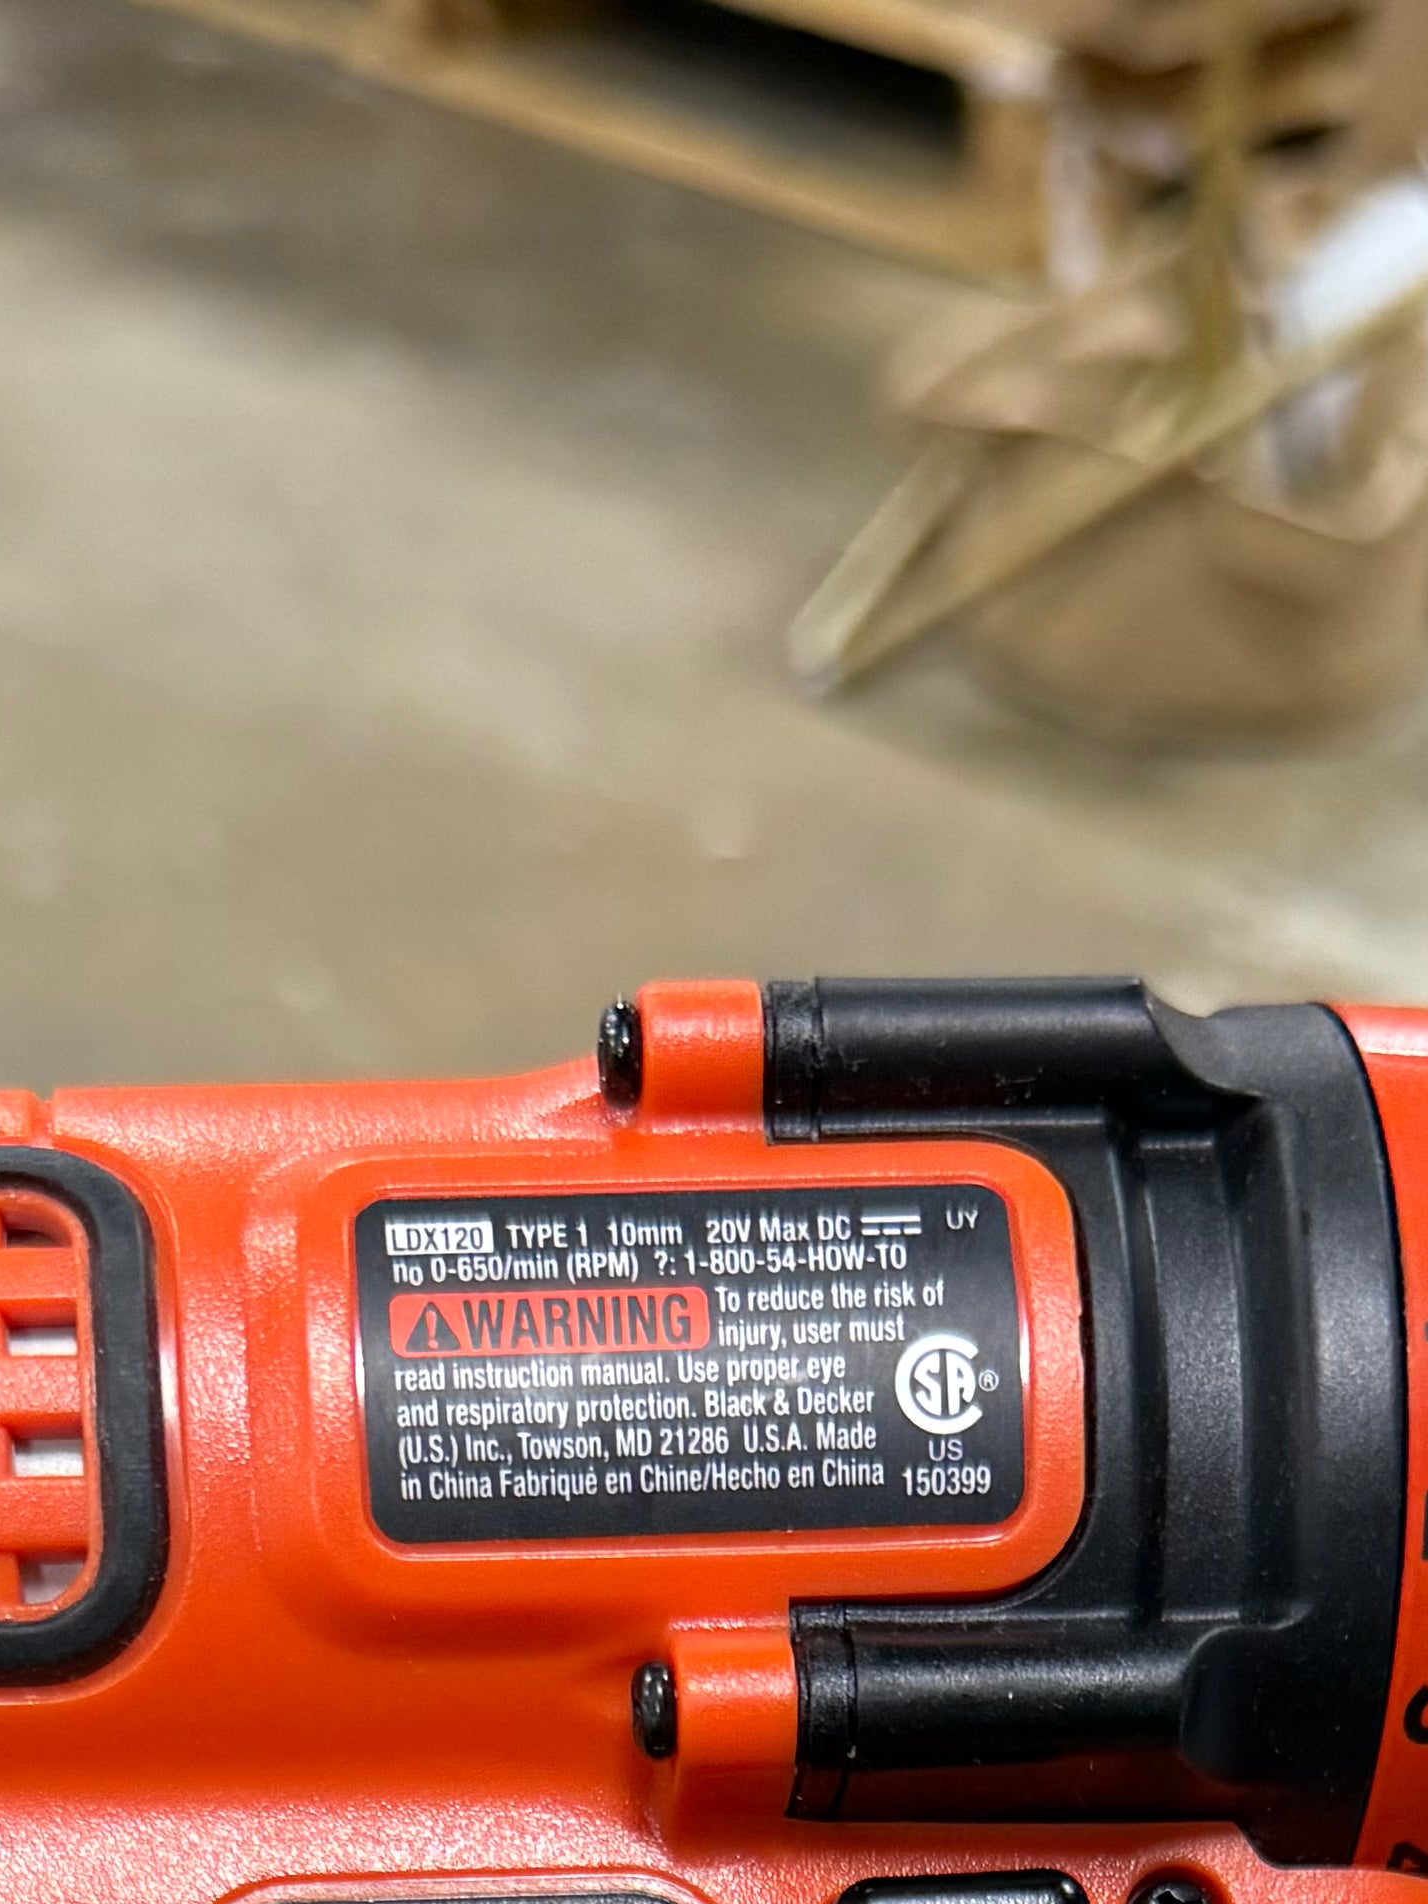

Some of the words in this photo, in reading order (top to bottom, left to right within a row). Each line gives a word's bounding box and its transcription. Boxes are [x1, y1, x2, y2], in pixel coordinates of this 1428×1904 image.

[391, 1227, 484, 1251] LDX120
[506, 1222, 568, 1249] TYPE
[576, 1219, 588, 1248] 1
[608, 1219, 682, 1247] 10mm
[706, 1217, 751, 1244] 20V
[759, 1216, 810, 1242] Max
[817, 1215, 851, 1241] DC
[946, 1208, 978, 1230] UY
[430, 1253, 559, 1282] 0-650/min
[567, 1250, 639, 1284] (RPM)
[684, 1243, 907, 1275] 1-800-54-HOW-TO
[714, 1285, 740, 1312] To
[748, 1281, 824, 1311] reduce
[831, 1281, 867, 1309] the
[874, 1280, 916, 1307] risk
[922, 1278, 945, 1306] of
[462, 1293, 691, 1349] WARNING
[718, 1319, 787, 1351] injury,
[793, 1319, 842, 1344] user
[849, 1315, 906, 1342] must
[394, 1362, 445, 1391] read
[452, 1360, 573, 1390] instruction
[580, 1358, 670, 1386] manual.
[677, 1355, 719, 1383] Use
[727, 1357, 800, 1386] proper
[807, 1357, 846, 1380] eye
[397, 1398, 438, 1427] and
[446, 1395, 570, 1431] respiratory
[576, 1391, 697, 1427] protection.
[705, 1388, 766, 1418] Black
[773, 1390, 790, 1416] &
[797, 1387, 875, 1416] Decker
[398, 1434, 459, 1469] (U.S.)
[465, 1433, 513, 1465] Inc.,
[518, 1431, 610, 1462] Towson,
[616, 1428, 652, 1457] MD
[660, 1426, 730, 1456] 21286
[743, 1423, 808, 1453] U.S.A.
[816, 1421, 877, 1451] Made
[928, 1438, 963, 1461] US
[401, 1471, 422, 1500] in
[429, 1470, 493, 1499] China
[499, 1465, 598, 1501] Fabriqué
[605, 1471, 632, 1494] en
[640, 1460, 780, 1492] Chine/Hecho
[788, 1465, 815, 1488] en
[822, 1458, 885, 1488] China
[902, 1465, 991, 1496] 150399
